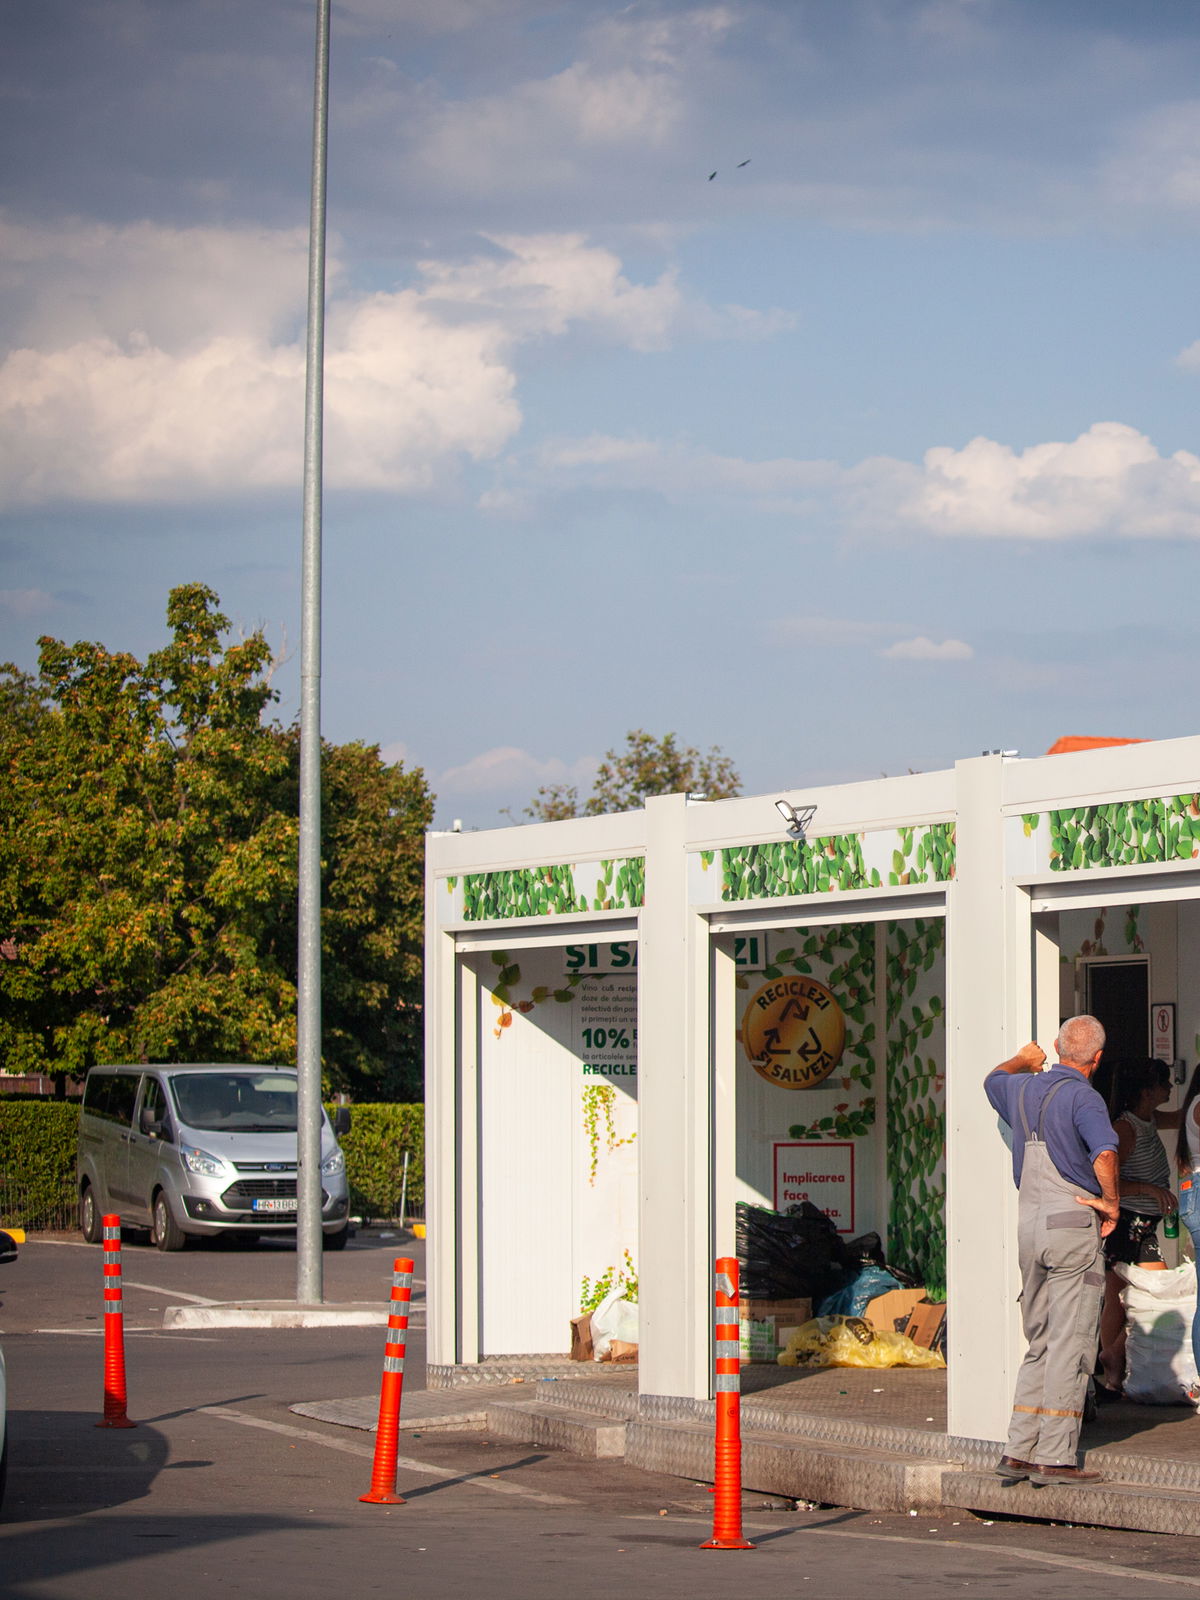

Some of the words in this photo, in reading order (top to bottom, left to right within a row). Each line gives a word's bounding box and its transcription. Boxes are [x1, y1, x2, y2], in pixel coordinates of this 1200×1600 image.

[581, 994, 598, 1002] doze
[601, 994, 609, 1002] de
[756, 981, 831, 1011] RECICLEZI
[581, 1004, 612, 1012] selectivă
[612, 1004, 623, 1012] din
[582, 1027, 630, 1049] 10%
[771, 1051, 834, 1083] SALVEZI
[783, 1172, 845, 1186] Implicarea
[783, 1190, 809, 1201] face
